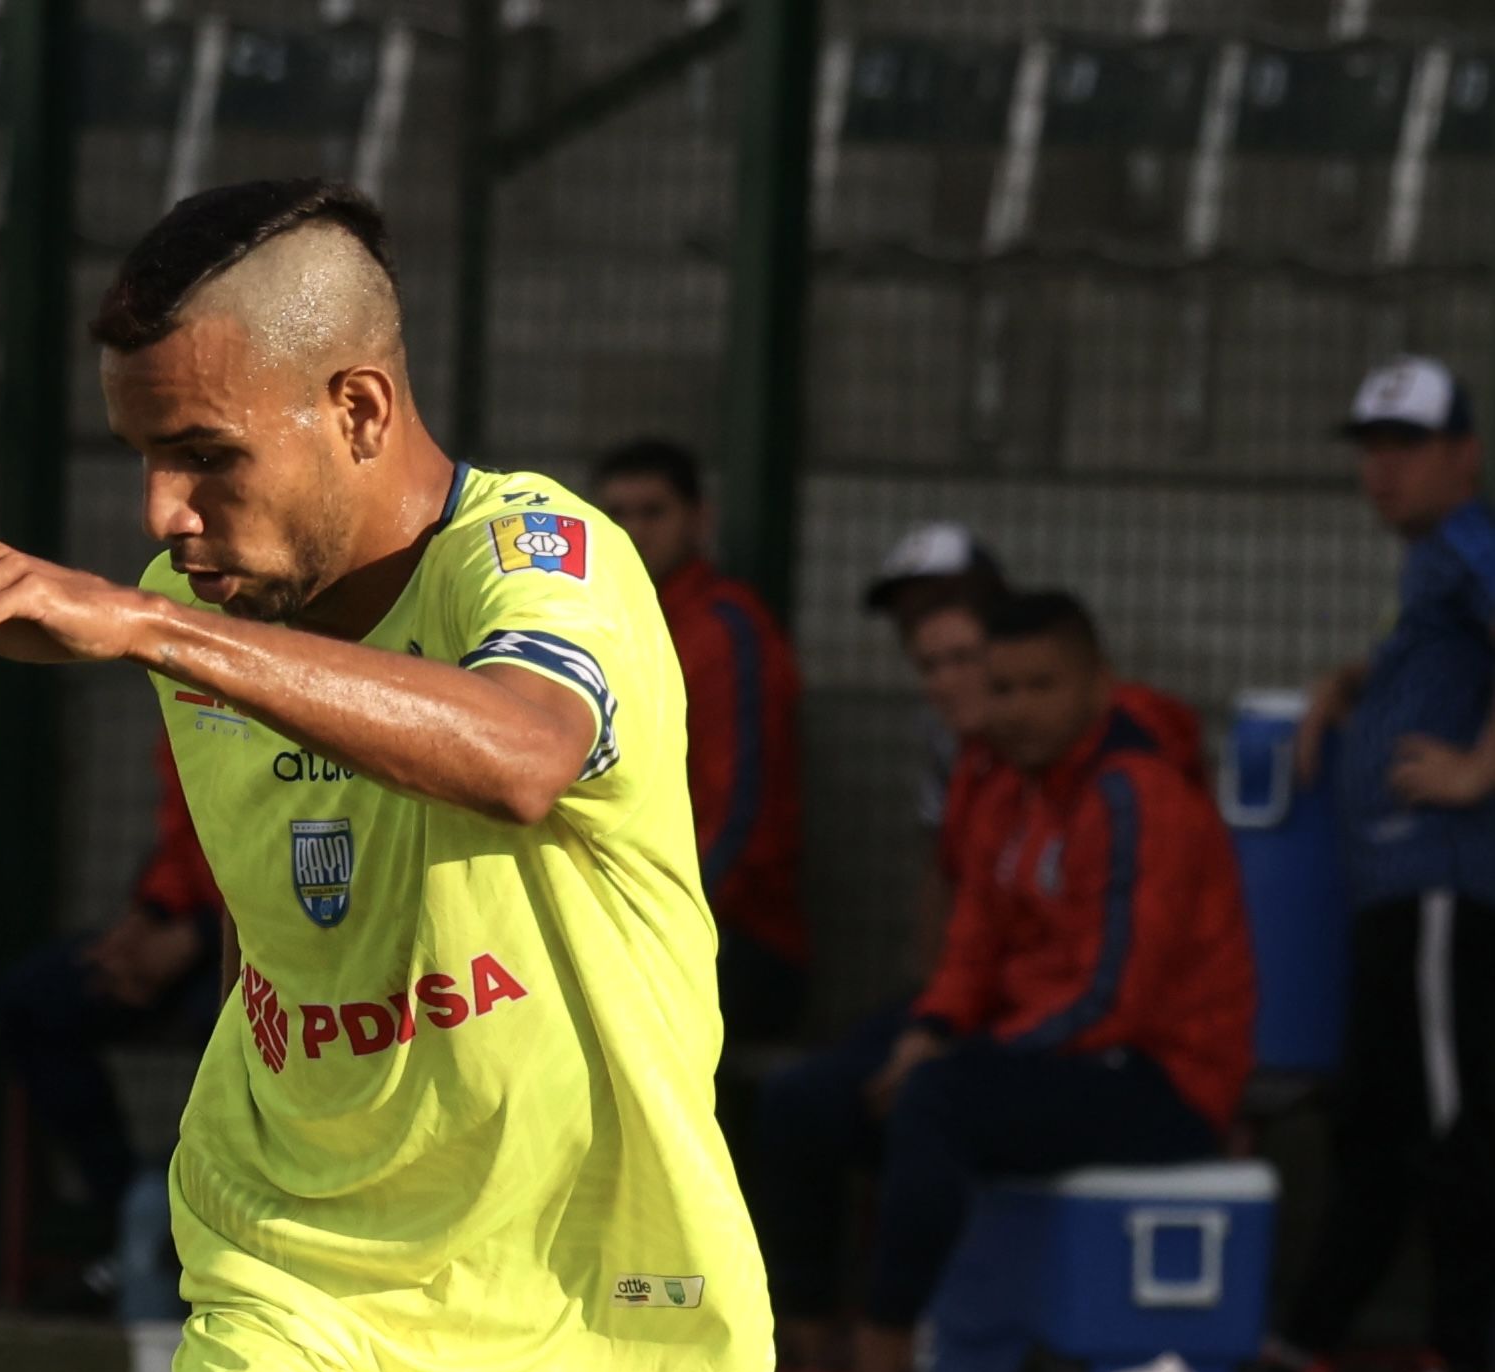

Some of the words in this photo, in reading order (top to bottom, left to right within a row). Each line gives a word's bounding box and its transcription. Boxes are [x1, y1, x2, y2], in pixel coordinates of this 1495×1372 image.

[273, 749, 355, 782] att
[295, 834, 350, 884] RAYO
[617, 1278, 652, 1294] attle
